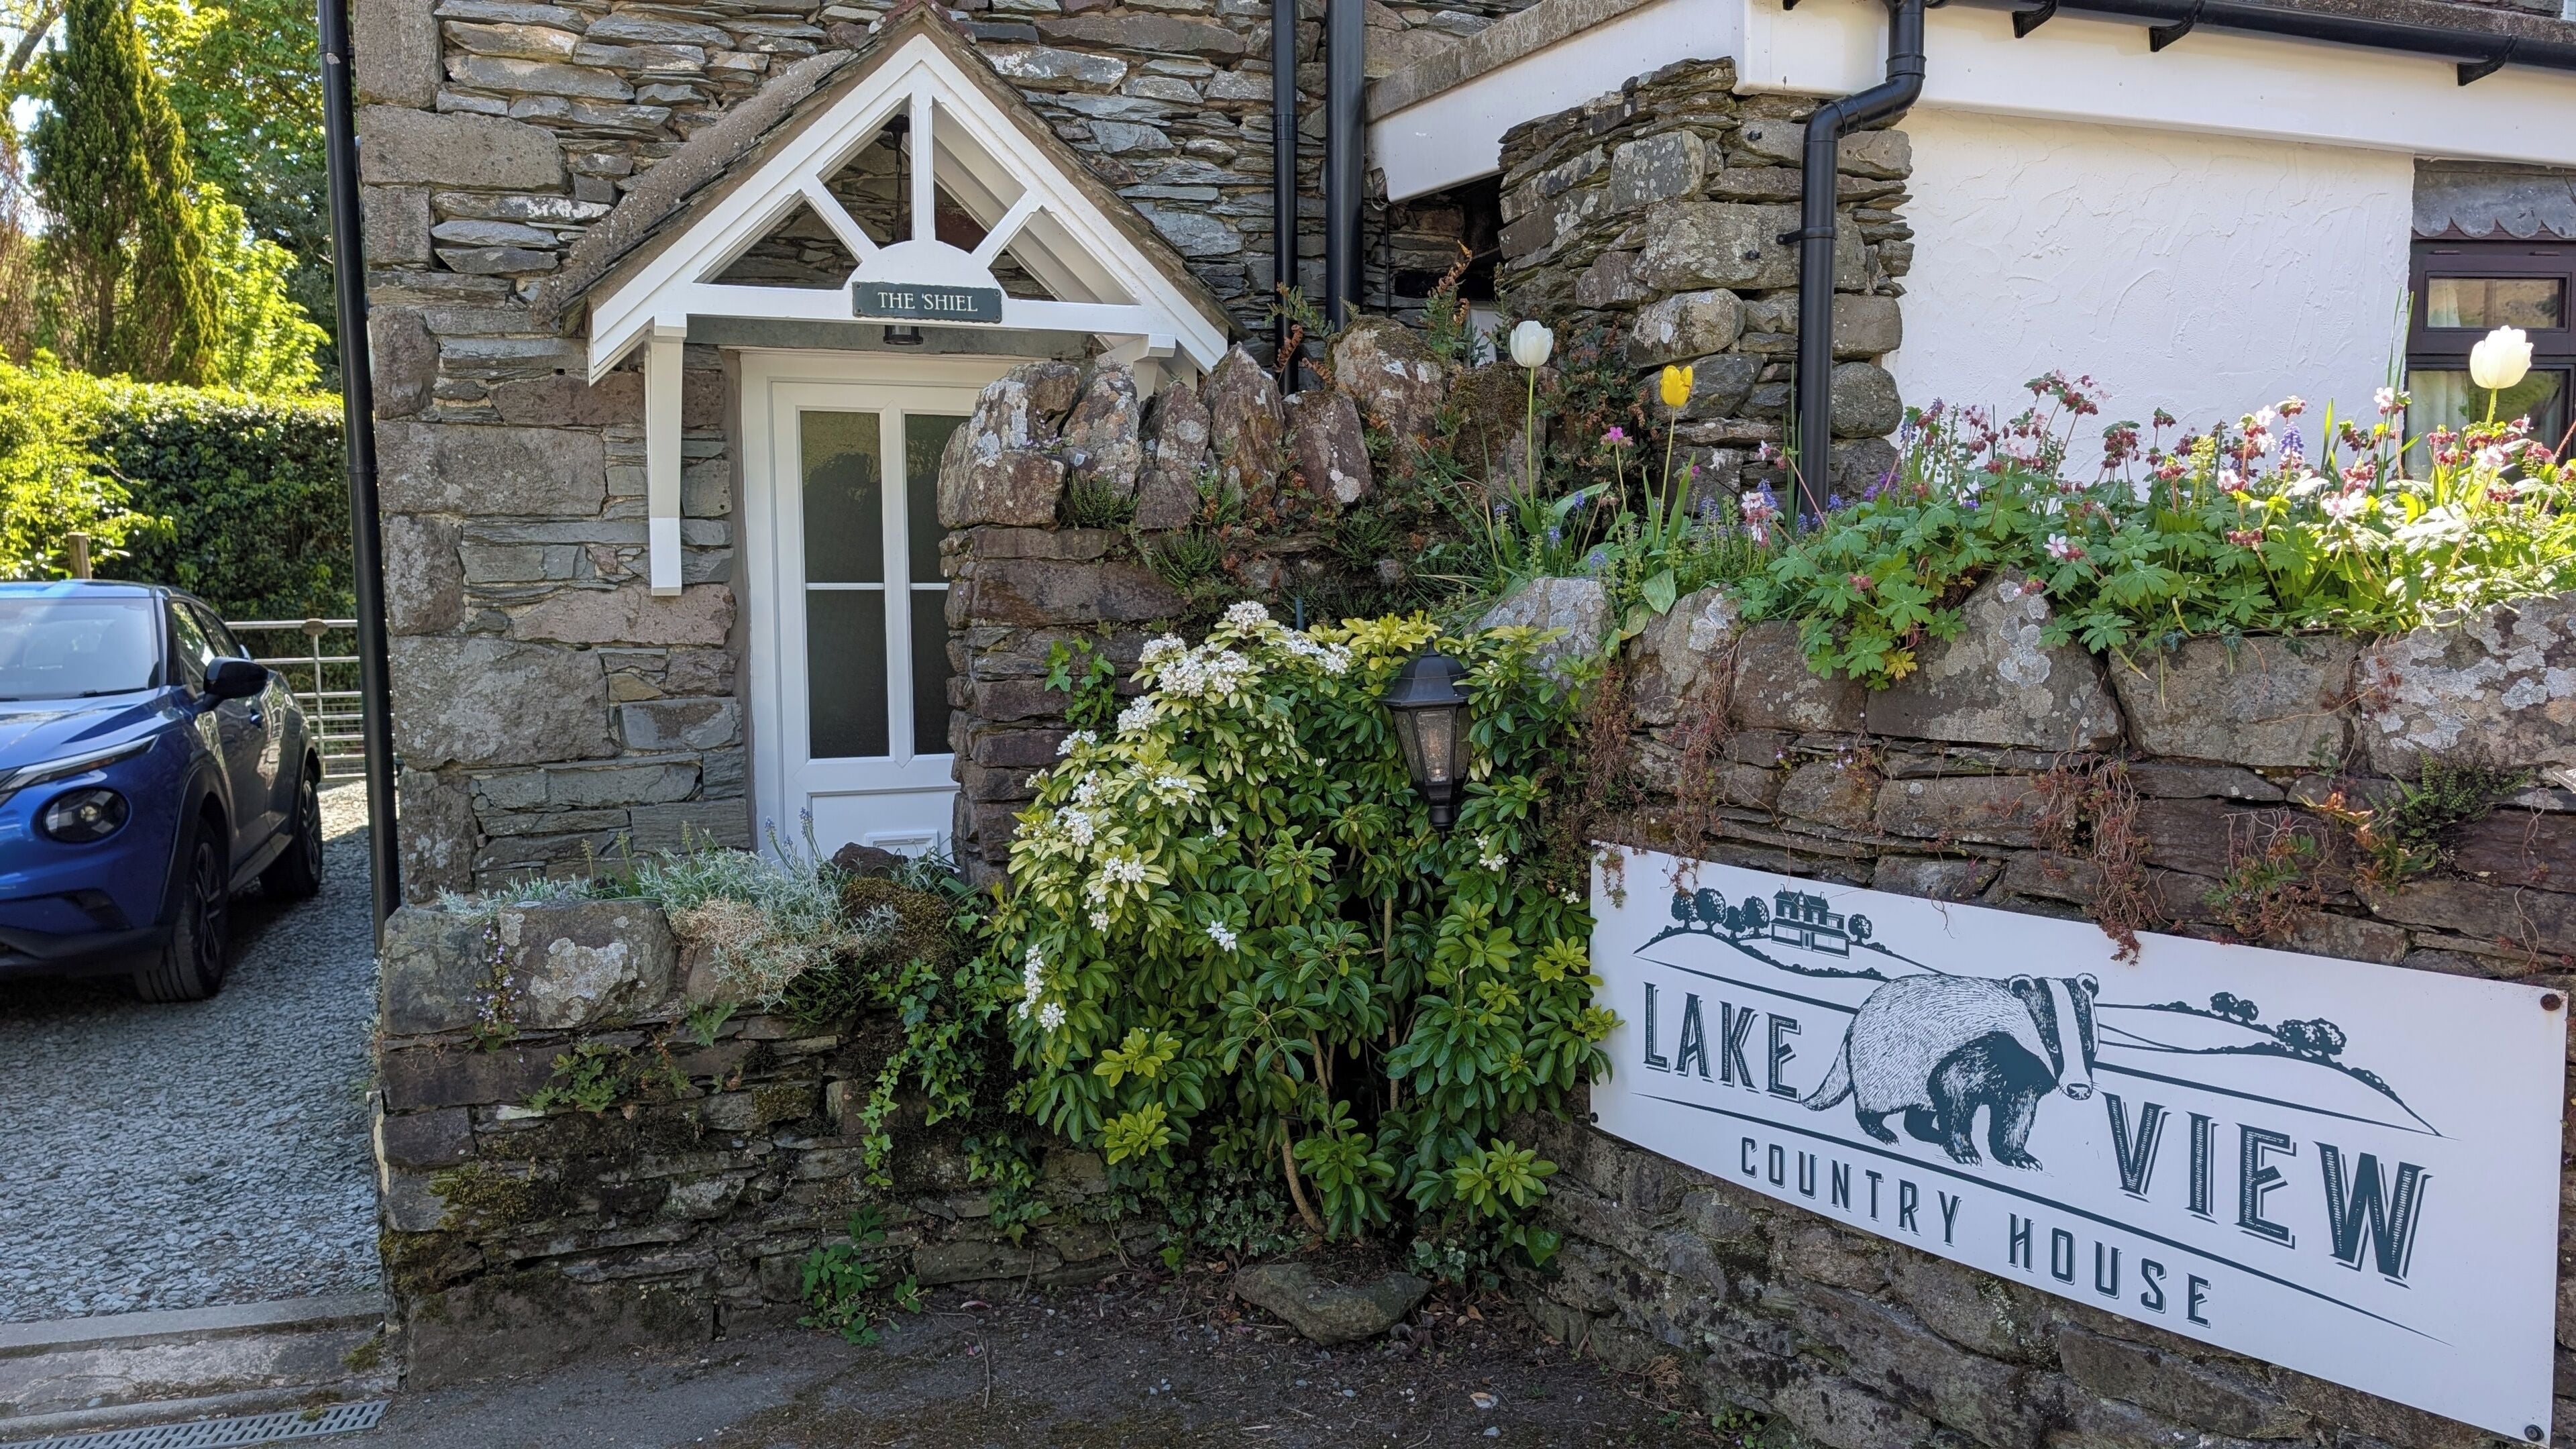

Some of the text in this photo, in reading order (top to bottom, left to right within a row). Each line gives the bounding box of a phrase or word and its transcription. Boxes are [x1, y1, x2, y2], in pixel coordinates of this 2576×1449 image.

[877, 292, 916, 309] THE
[1643, 981, 2434, 1289] LAKE VIEW
[1741, 1136, 2213, 1329] COUNTRY HOUSE
